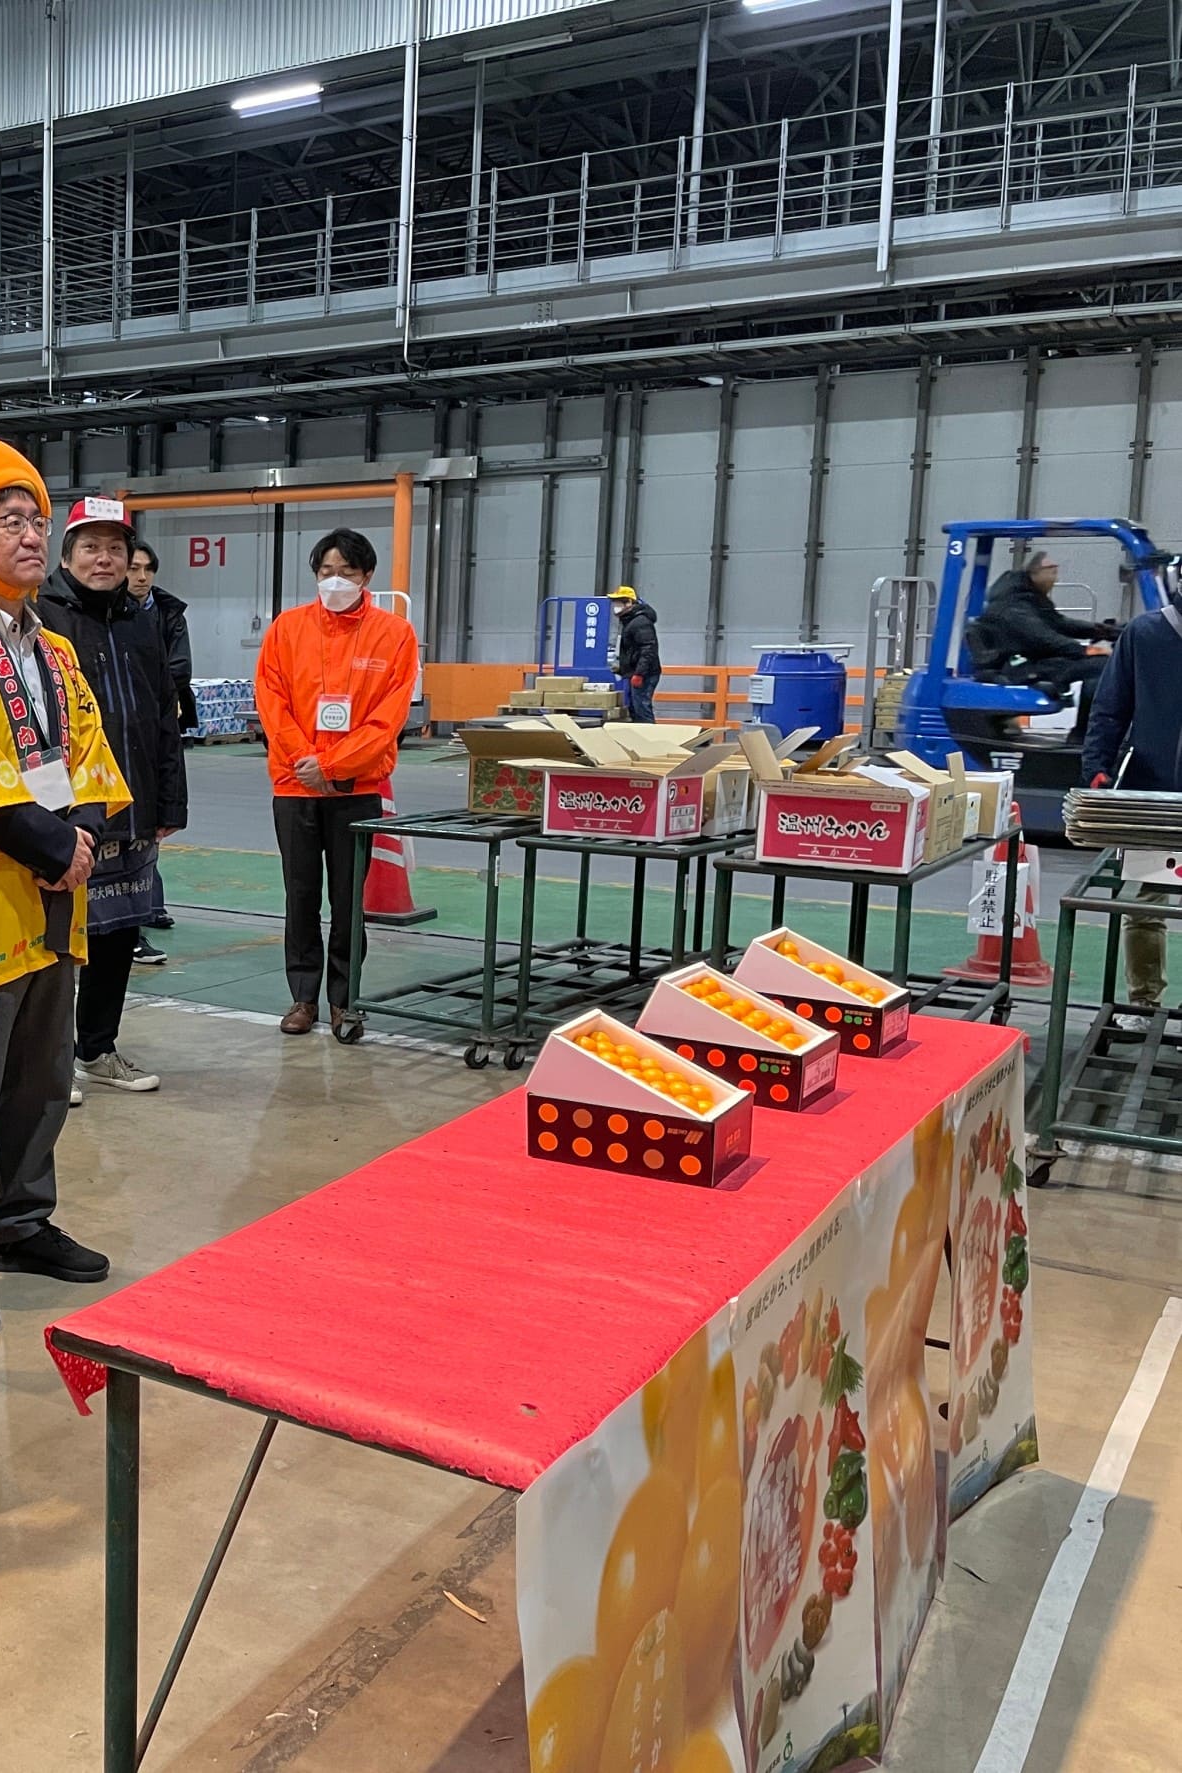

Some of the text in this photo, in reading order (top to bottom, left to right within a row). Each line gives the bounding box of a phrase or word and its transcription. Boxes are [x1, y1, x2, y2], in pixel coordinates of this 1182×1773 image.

[190, 536, 226, 567] B1
[950, 541, 963, 555] 3
[558, 790, 645, 814] 温州みかん
[778, 813, 890, 840] 温州みかん
[810, 847, 859, 858] みかん
[980, 869, 999, 929] 駐車禁止
